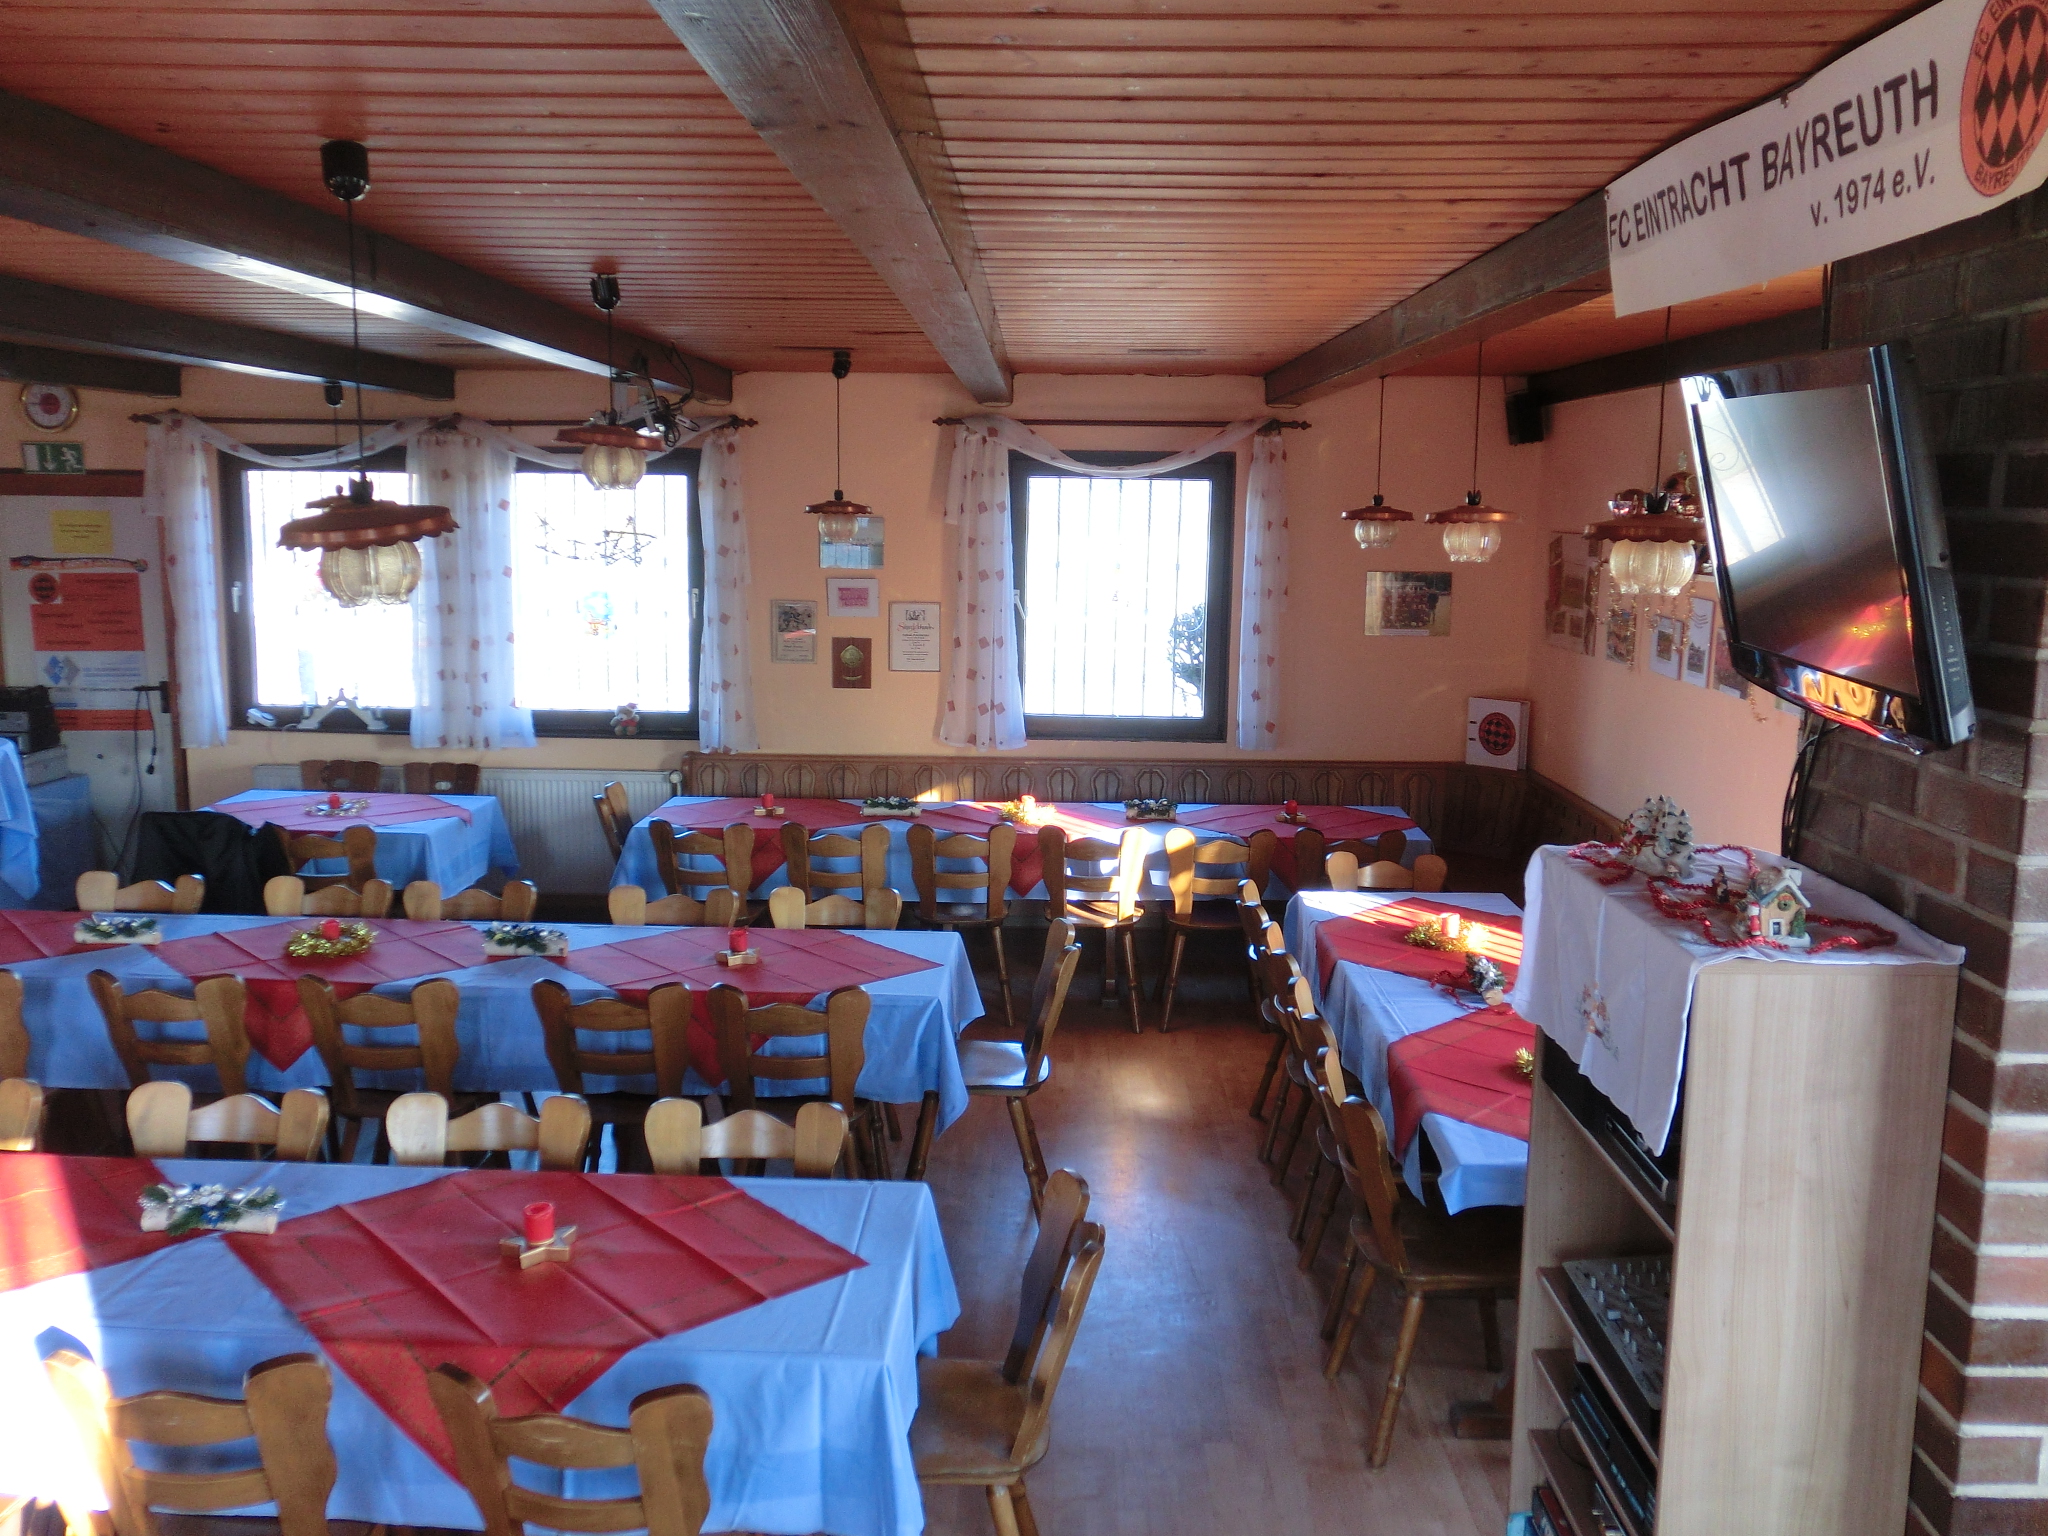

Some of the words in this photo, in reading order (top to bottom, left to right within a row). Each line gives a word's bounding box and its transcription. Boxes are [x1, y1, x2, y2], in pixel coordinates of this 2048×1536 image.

[1609, 209, 1631, 252] FC
[1633, 152, 1750, 242] EINTRACHT
[1762, 58, 1939, 191] BAYREUTH
[1810, 201, 1828, 227] v.
[1834, 167, 1886, 219] 1974
[1892, 147, 1935, 198] e.V.
